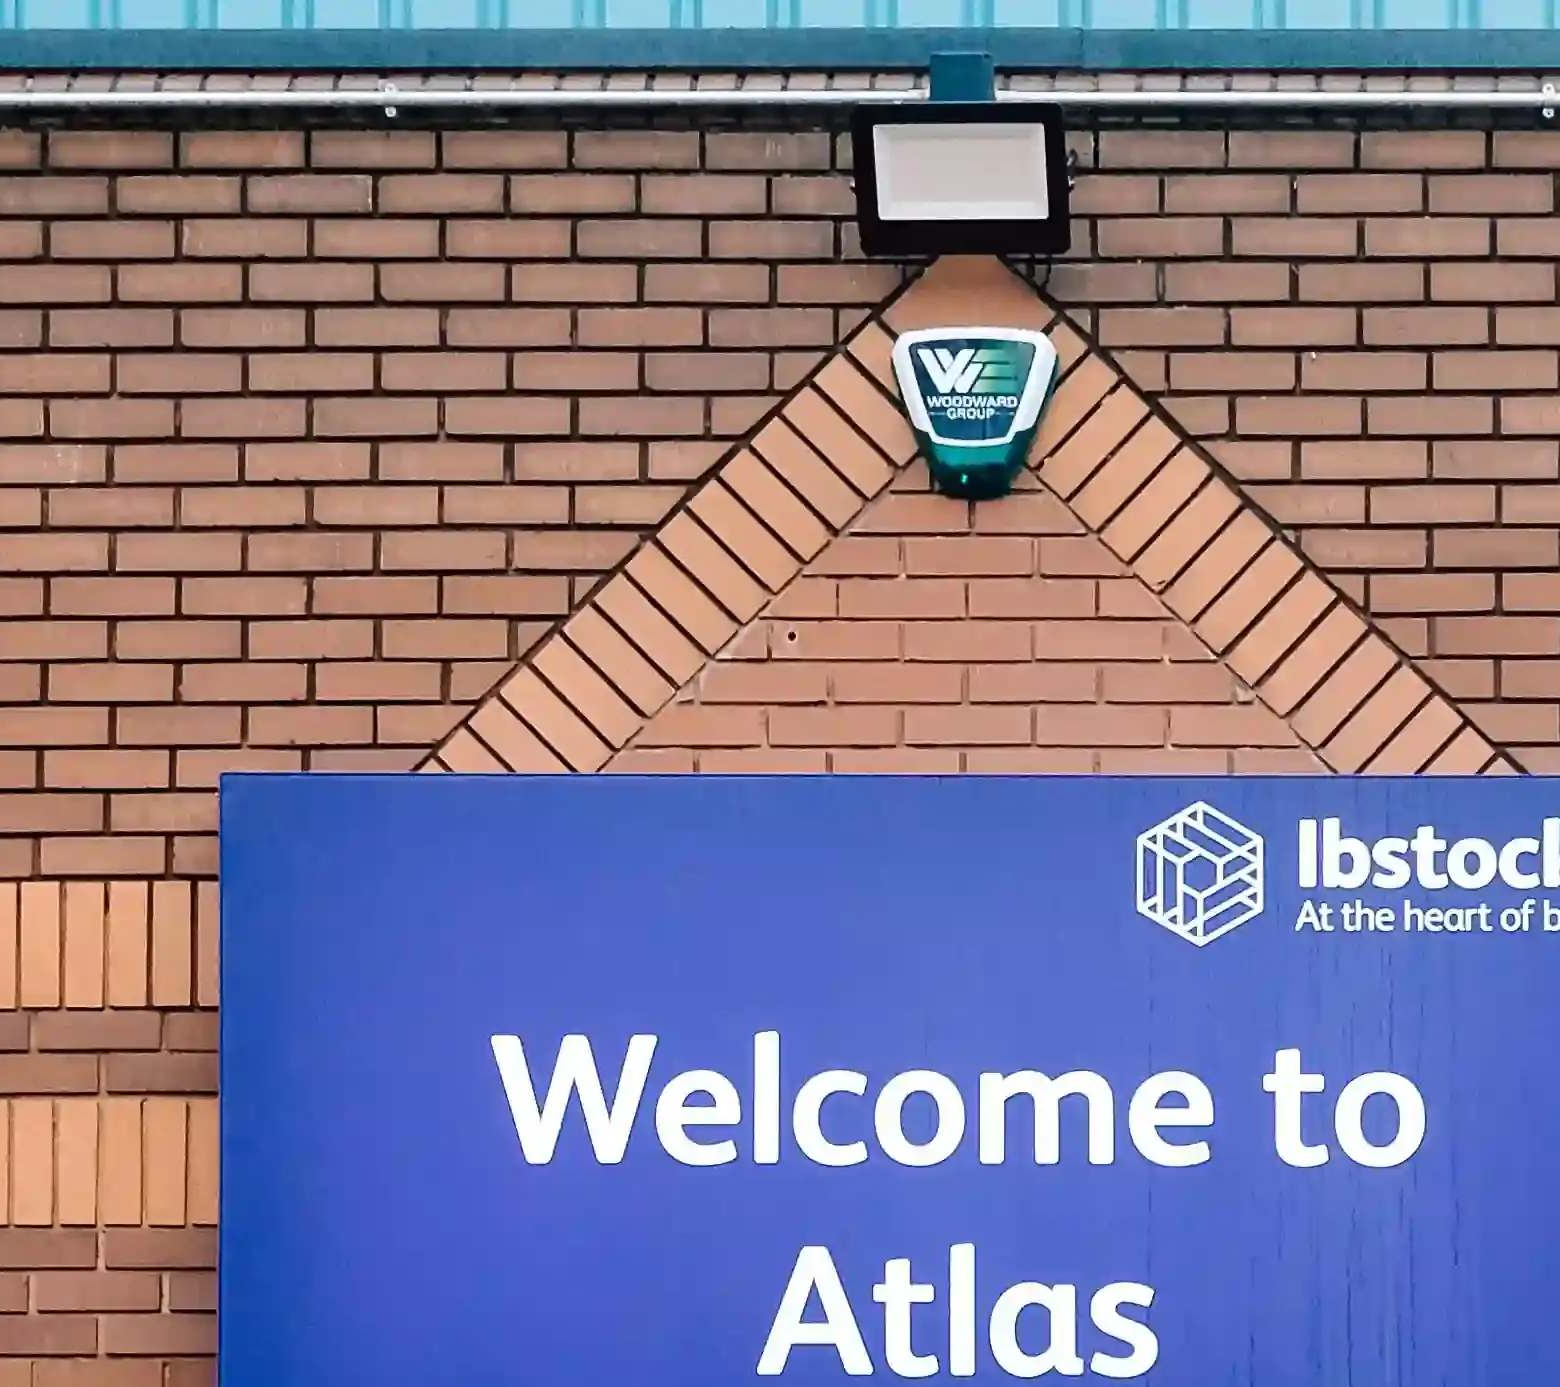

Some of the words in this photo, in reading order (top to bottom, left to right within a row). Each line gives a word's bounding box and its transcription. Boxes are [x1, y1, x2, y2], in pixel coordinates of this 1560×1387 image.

[926, 396, 1018, 408] WOODWARD
[946, 408, 995, 420] GROUP
[1295, 900, 1334, 932] At
[1340, 900, 1395, 932] the
[1404, 900, 1493, 932] heart
[1500, 899, 1535, 932] of
[491, 1031, 1213, 1167] Welcome
[1263, 1049, 1426, 1168] to
[757, 1243, 1159, 1378] Atlas
